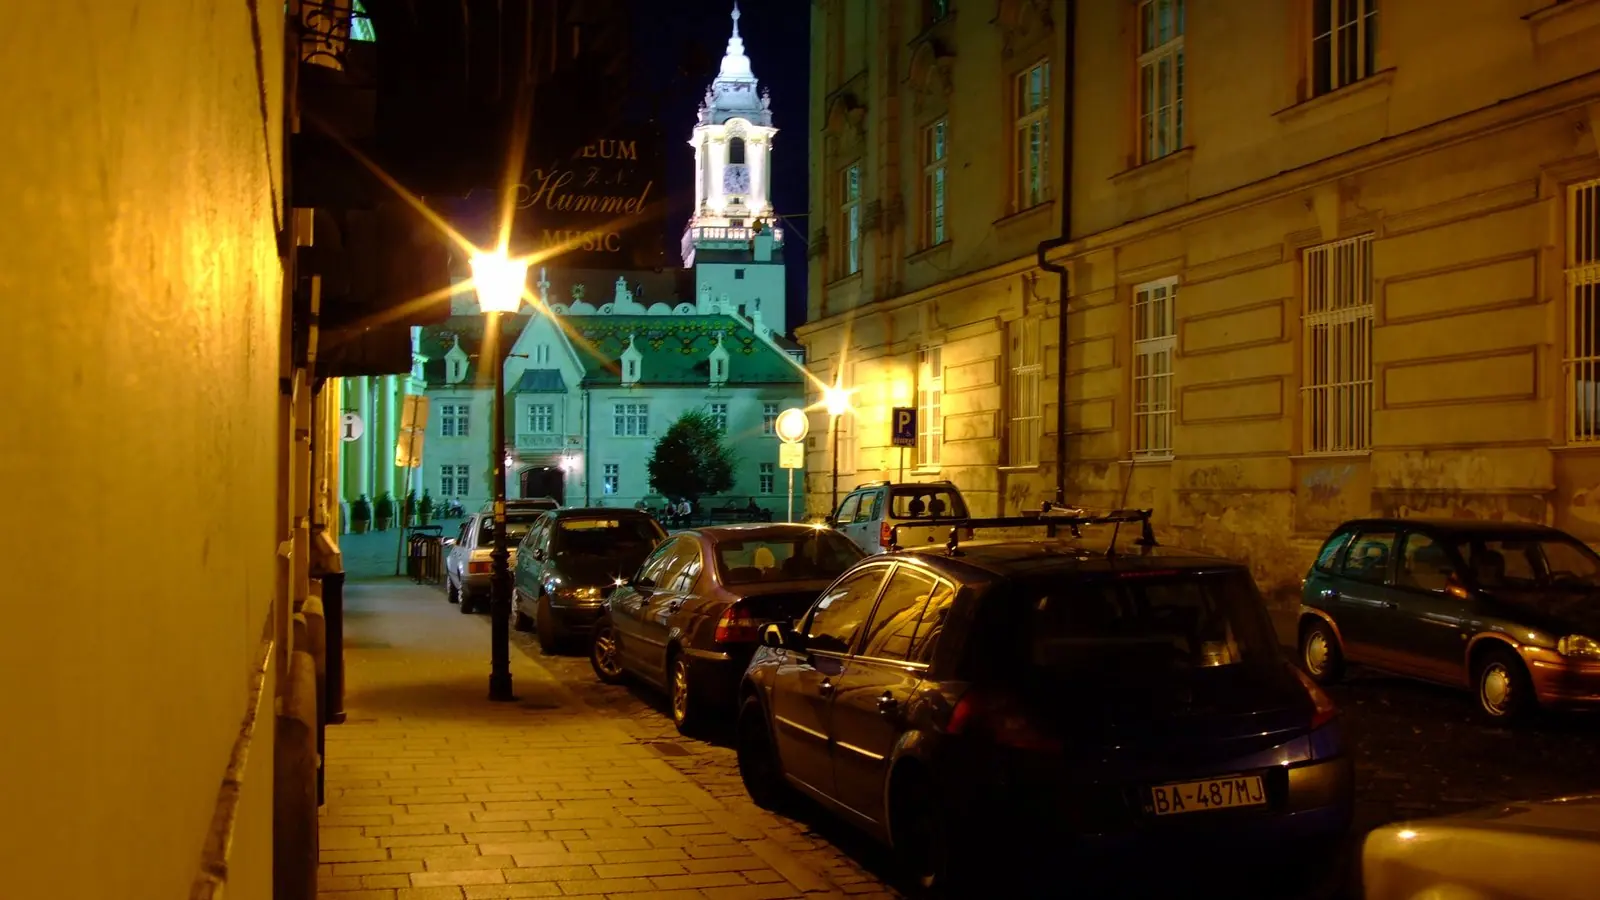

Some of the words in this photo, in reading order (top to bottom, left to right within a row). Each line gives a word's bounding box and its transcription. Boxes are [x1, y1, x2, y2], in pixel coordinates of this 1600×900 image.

[510, 168, 655, 214] Hummel
[541, 228, 622, 253] MUSIC
[343, 415, 356, 439] i
[898, 411, 912, 434] P
[1154, 777, 1265, 814] BA-487MJ
